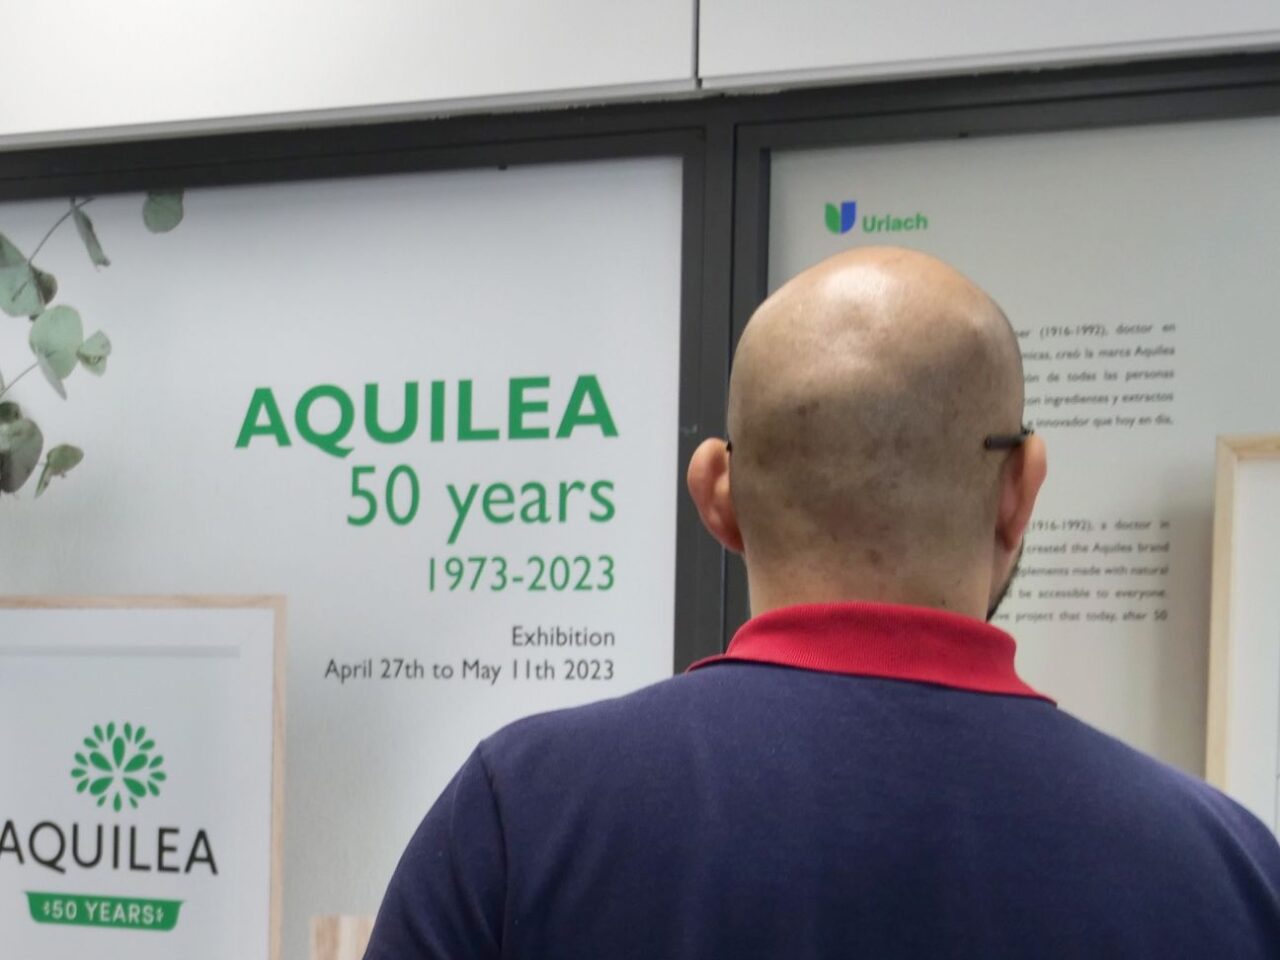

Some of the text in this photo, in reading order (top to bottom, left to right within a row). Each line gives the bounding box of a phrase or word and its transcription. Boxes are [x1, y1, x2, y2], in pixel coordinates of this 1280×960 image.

[862, 213, 929, 233] Uriach
[1115, 323, 1153, 335] doctor
[1162, 323, 1176, 334] en
[1084, 347, 1095, 359] la
[1099, 348, 1131, 358] marca
[1134, 345, 1176, 358] Aquilea
[1046, 370, 1060, 382] de
[1066, 370, 1097, 382] todas
[1103, 369, 1118, 381] las
[1125, 369, 1175, 382] personas
[1043, 394, 1109, 408] ingredientes
[1121, 392, 1174, 403] extractos
[234, 374, 619, 458] AQUILEA
[1036, 416, 1089, 428] innovador
[1092, 417, 1113, 429] que
[1115, 414, 1136, 429] hoy
[1138, 416, 1153, 426] en
[347, 464, 616, 545] 50 years
[1113, 518, 1152, 531] doctor
[1026, 541, 1170, 556] created the Aquilea brand
[428, 555, 615, 592] 1973-2023
[1072, 564, 1101, 575] made
[1104, 564, 1127, 575] with
[1130, 563, 1170, 575] natural
[1018, 588, 1032, 598] be
[1038, 587, 1090, 598] accessible
[1096, 589, 1109, 598] to
[1015, 611, 1054, 623] project
[1060, 609, 1080, 620] that
[1122, 608, 1147, 621] after
[1154, 607, 1168, 621] 50
[511, 626, 615, 647] Exhibition
[324, 657, 615, 685] April 27th to May 11th 2023
[52, 899, 155, 925] 50 YEARS
